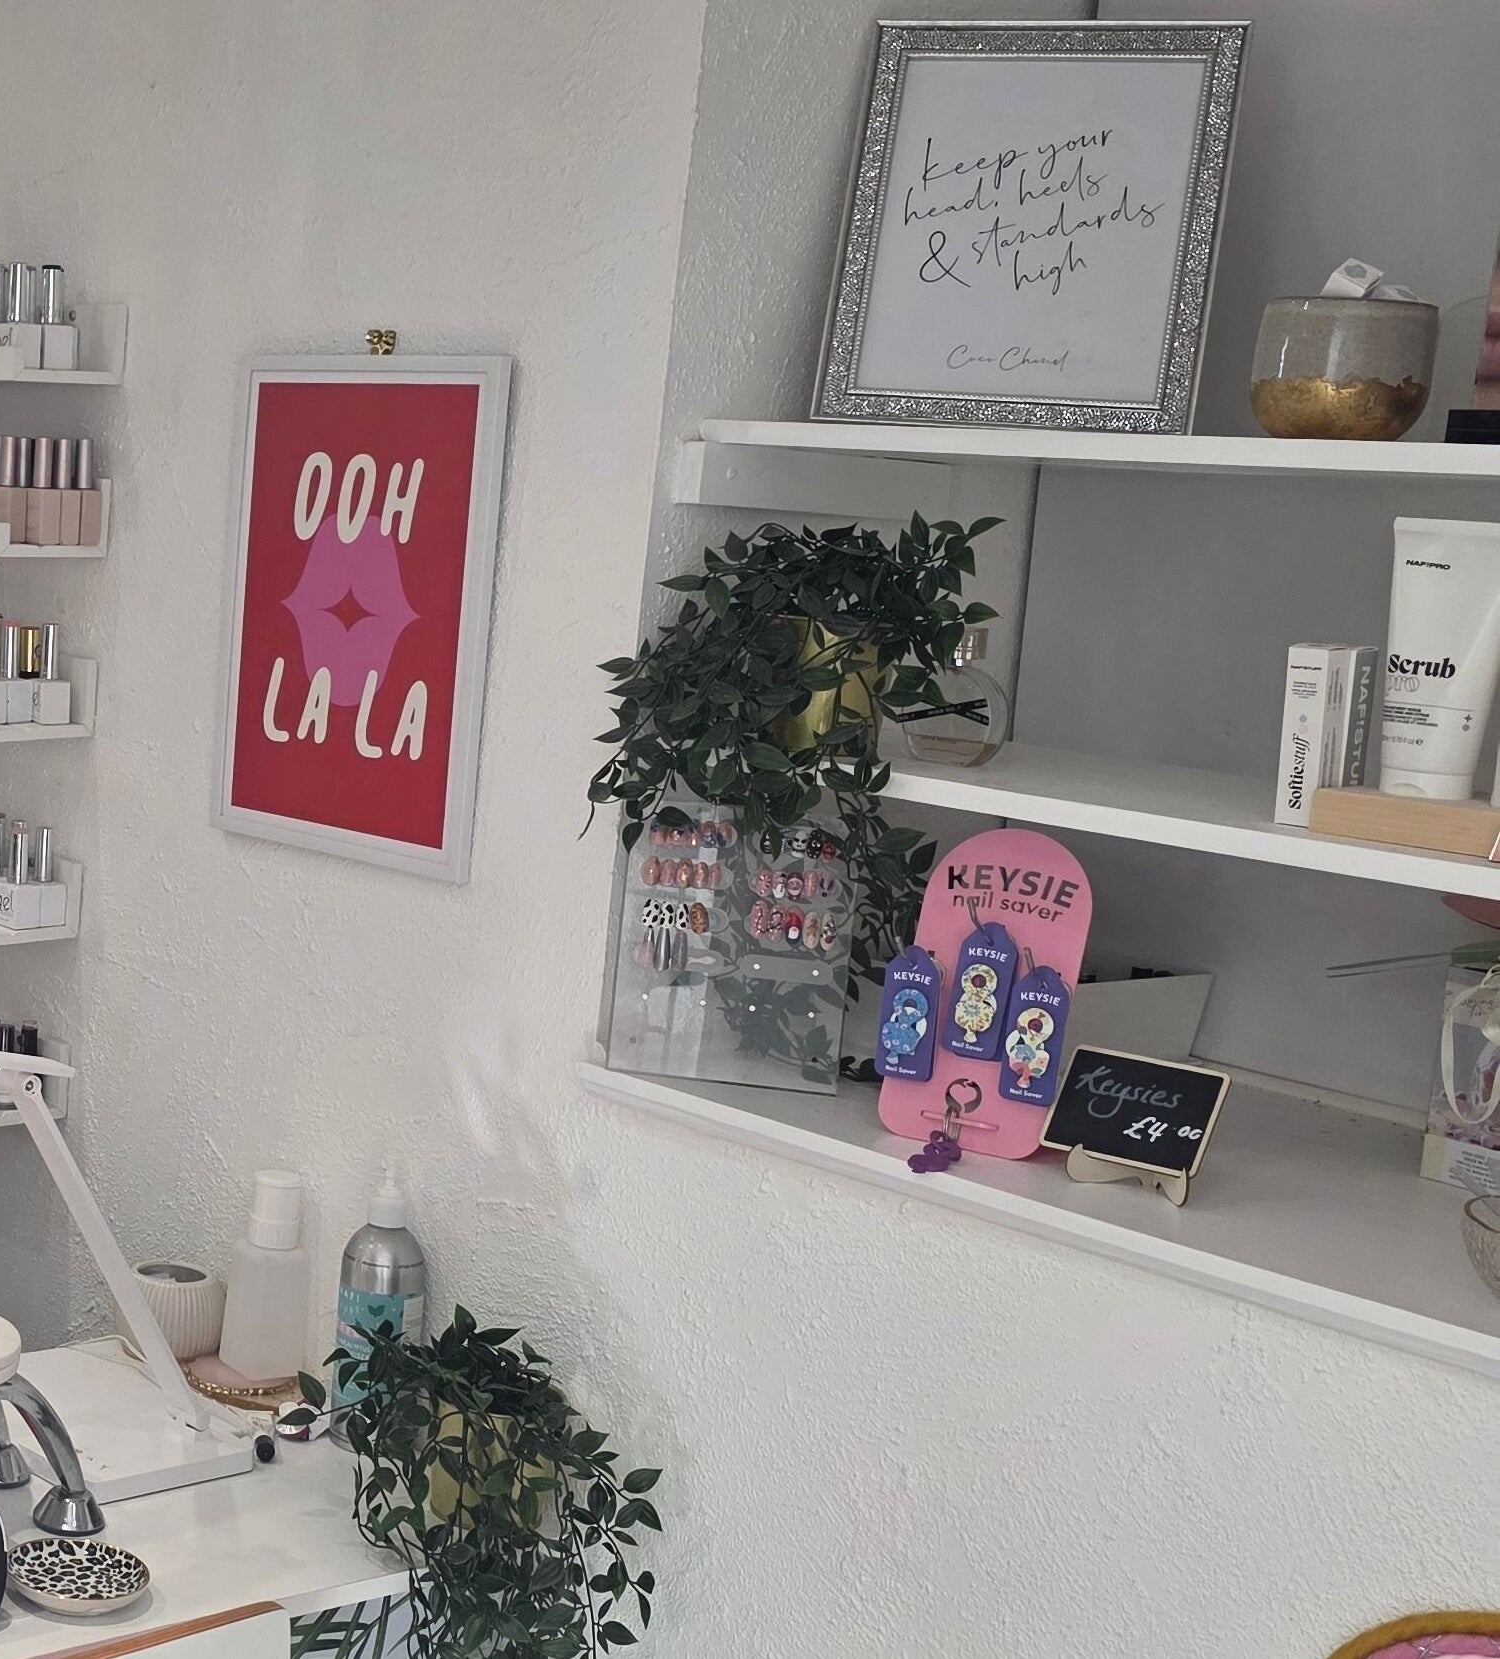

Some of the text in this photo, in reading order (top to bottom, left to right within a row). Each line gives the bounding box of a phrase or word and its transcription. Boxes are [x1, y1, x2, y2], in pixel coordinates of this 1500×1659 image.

[923, 129, 1113, 191] keep your
[1019, 156, 1109, 207] heels
[919, 186, 1166, 288] & standards
[1014, 241, 1088, 296] high
[293, 451, 424, 544] OOH
[1388, 654, 1456, 678] Scrub
[262, 657, 428, 761] LA LA
[948, 865, 1080, 909] KEYSIE
[953, 891, 1064, 922] nail saver
[968, 947, 1008, 963] KEYSIE
[893, 971, 932, 986] KEYSIE
[1020, 991, 1061, 1006] KEYSIE
[952, 1039, 984, 1052] Nail Saver
[1009, 1087, 1043, 1099] Nail Saver
[1075, 1066, 1183, 1118] Keysies
